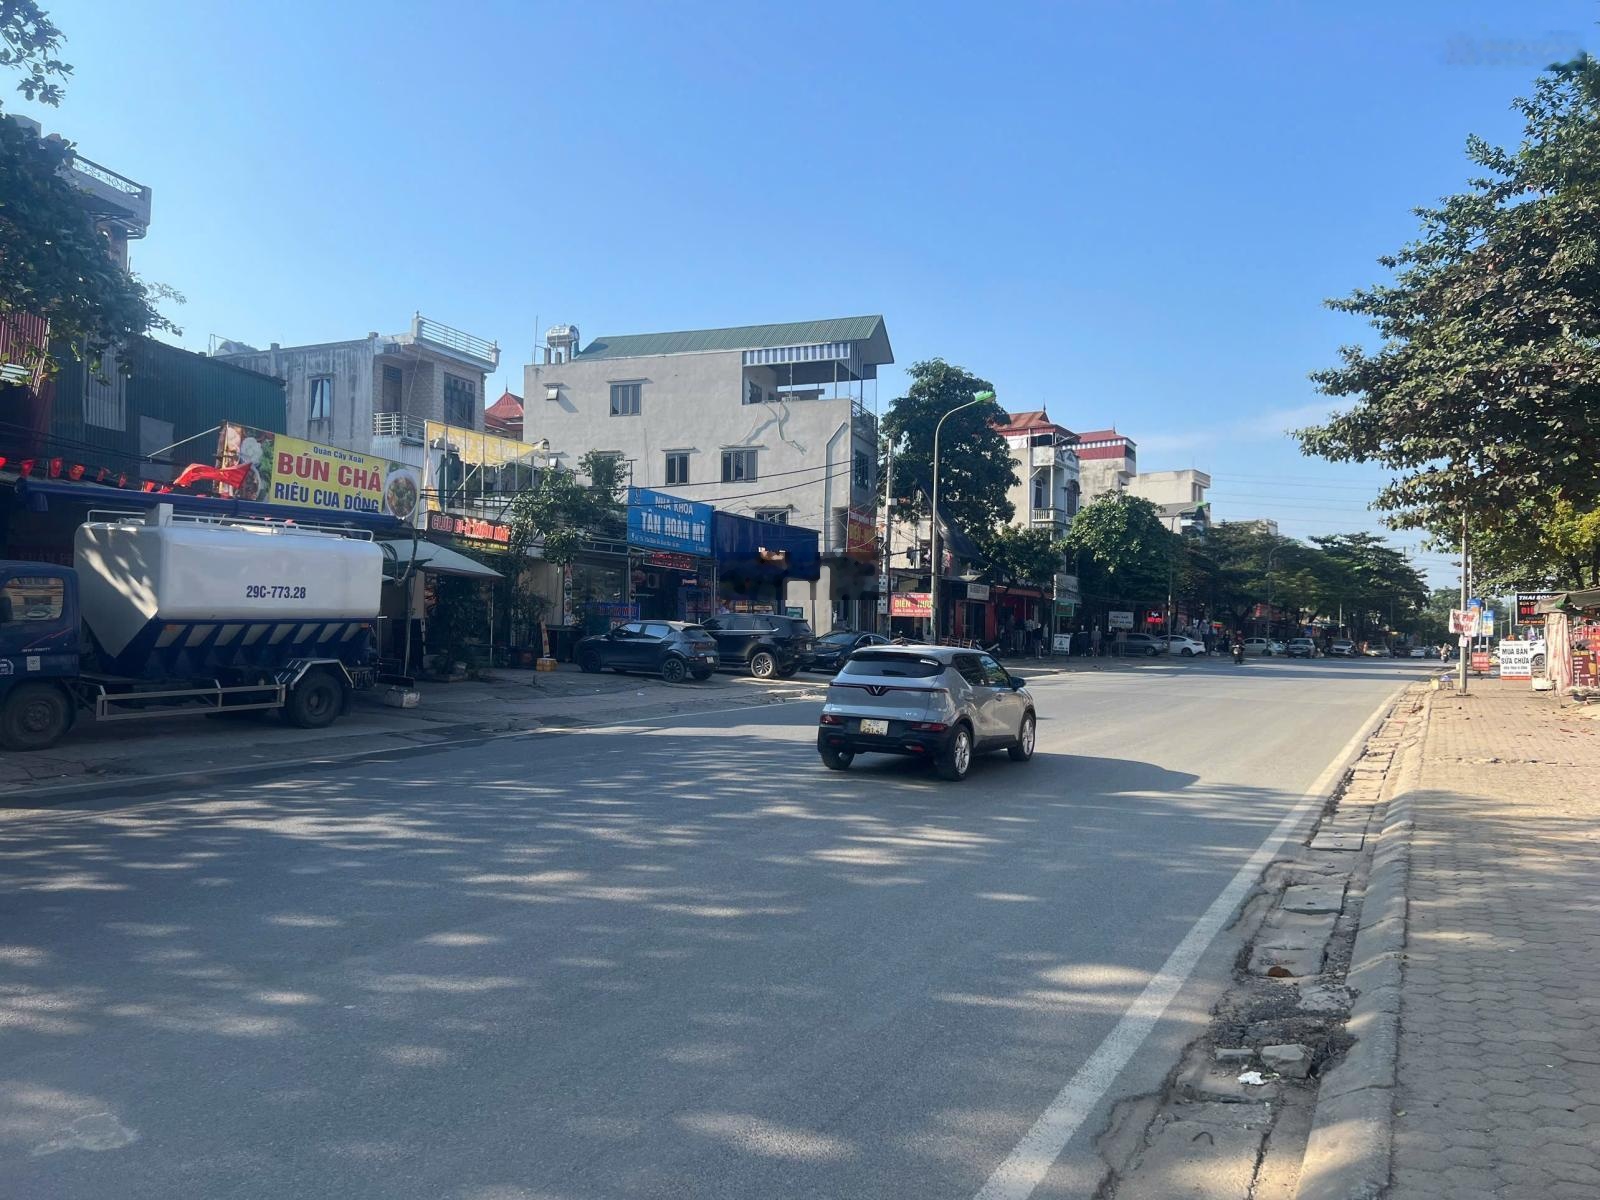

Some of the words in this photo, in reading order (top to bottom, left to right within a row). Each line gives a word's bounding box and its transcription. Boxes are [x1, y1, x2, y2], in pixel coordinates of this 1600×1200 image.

[277, 452, 330, 482] BÚN
[338, 465, 382, 492] CHẢ
[274, 481, 309, 503] RIÊU
[313, 488, 340, 508] CUA
[344, 490, 379, 513] ĐỒNG
[655, 495, 671, 511] NHA
[673, 501, 693, 515] KHOA
[641, 508, 660, 534] TÂN
[246, 585, 306, 599] 29C-773.28
